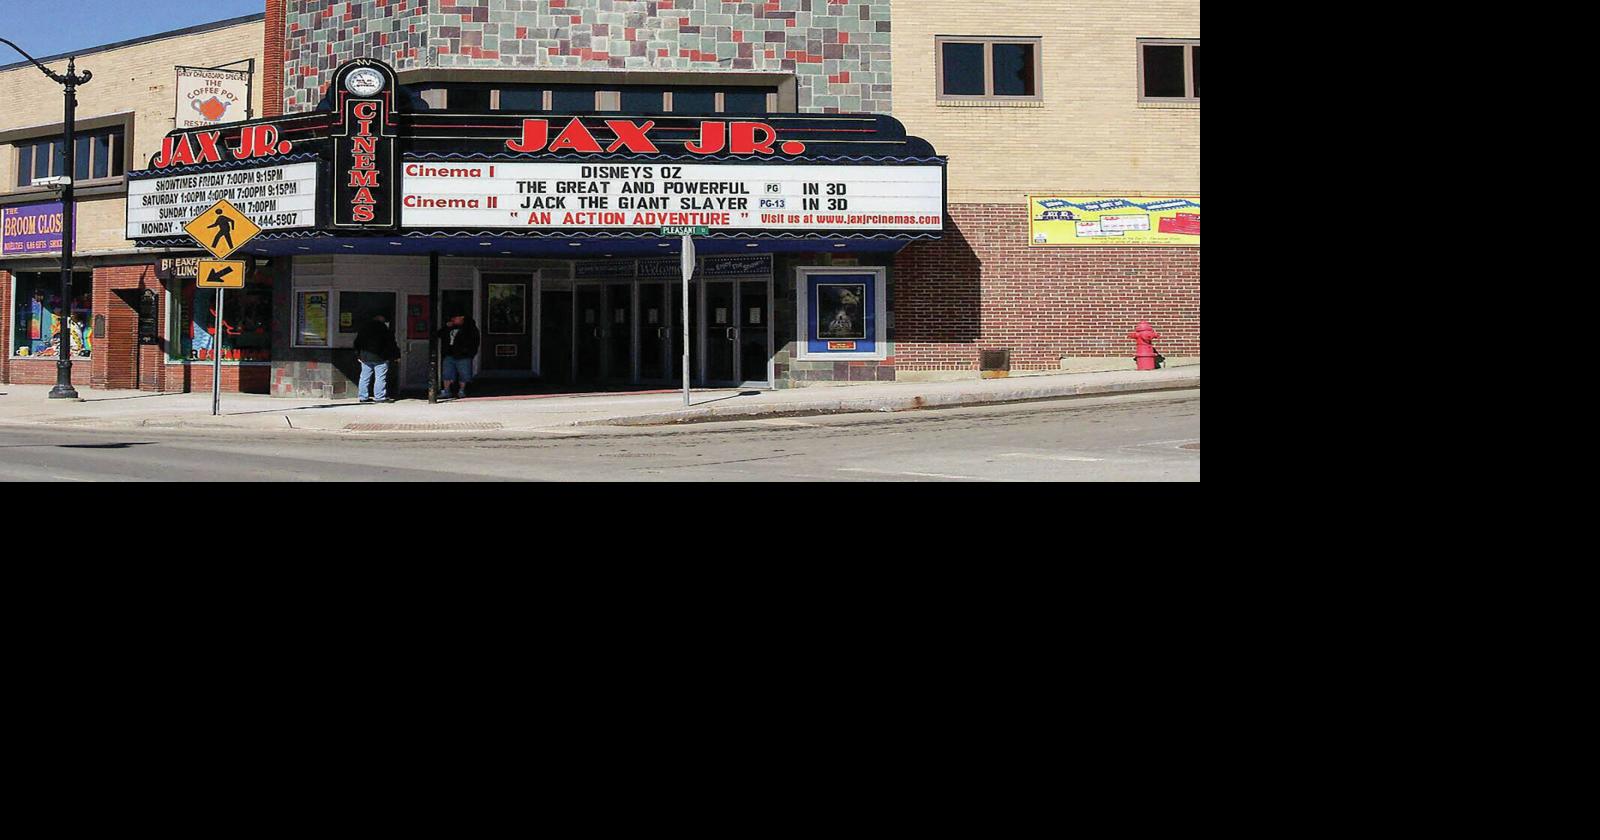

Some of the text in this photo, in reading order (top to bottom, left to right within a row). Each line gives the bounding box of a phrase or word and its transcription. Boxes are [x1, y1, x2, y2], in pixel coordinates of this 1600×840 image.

[187, 87, 239, 102] COFFEE POT
[504, 116, 806, 155] JAX JR.
[153, 124, 293, 169] JAX JR.
[348, 101, 380, 222] CINEMAS
[405, 164, 495, 178] Cinema I
[581, 166, 682, 179] DISNEYS OZ
[155, 169, 283, 192] SHOWTIMES FRIDAY 7:00PM 9:15PM
[516, 181, 847, 195] THE GREAT AND POWERFUL PG IN 3D
[142, 182, 297, 206] SATURDAY 1:00PM 4:00PM 7:00PM 9:15PM
[403, 194, 498, 209] Cinema II
[158, 205, 188, 219] SUNDAY
[247, 199, 277, 213] 7:00PM
[520, 196, 848, 211] JACK THE GIANT SLAYER PG-13 IN 3D
[141, 219, 174, 234] MONDAY
[257, 212, 298, 227] 444-5907
[528, 211, 551, 225] AN
[562, 211, 625, 225] ACTION
[632, 211, 730, 225] ADVENTURE
[761, 213, 940, 226] Visit us at www.jaxjrcinemas.com
[4, 215, 37, 237] BROOM
[663, 226, 696, 234] PLEASANT
